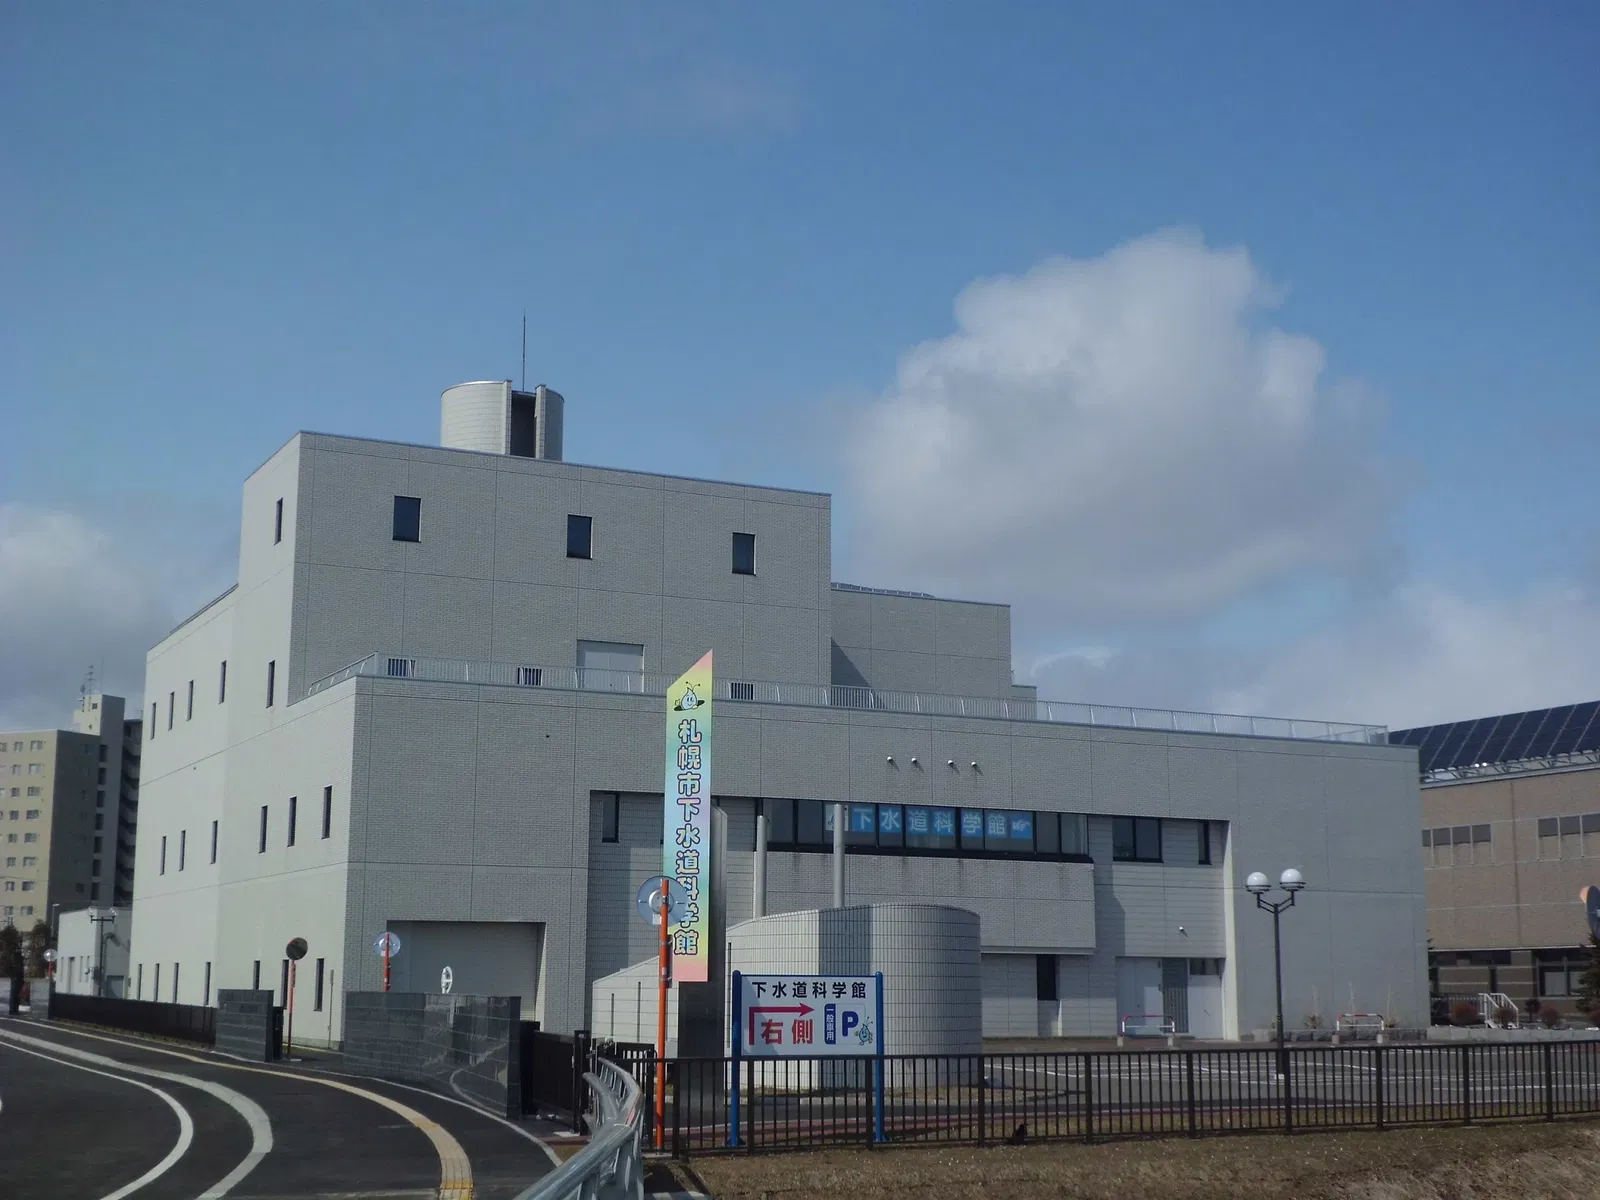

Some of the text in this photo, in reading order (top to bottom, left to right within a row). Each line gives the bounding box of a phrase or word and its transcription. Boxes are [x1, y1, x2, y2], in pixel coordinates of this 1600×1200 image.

[853, 808, 1006, 835] 下水道科学館
[752, 981, 866, 999] 下水道科学館
[761, 1019, 813, 1045] 右側
[826, 1008, 834, 1041] 一般車用
[841, 1011, 859, 1037] P
